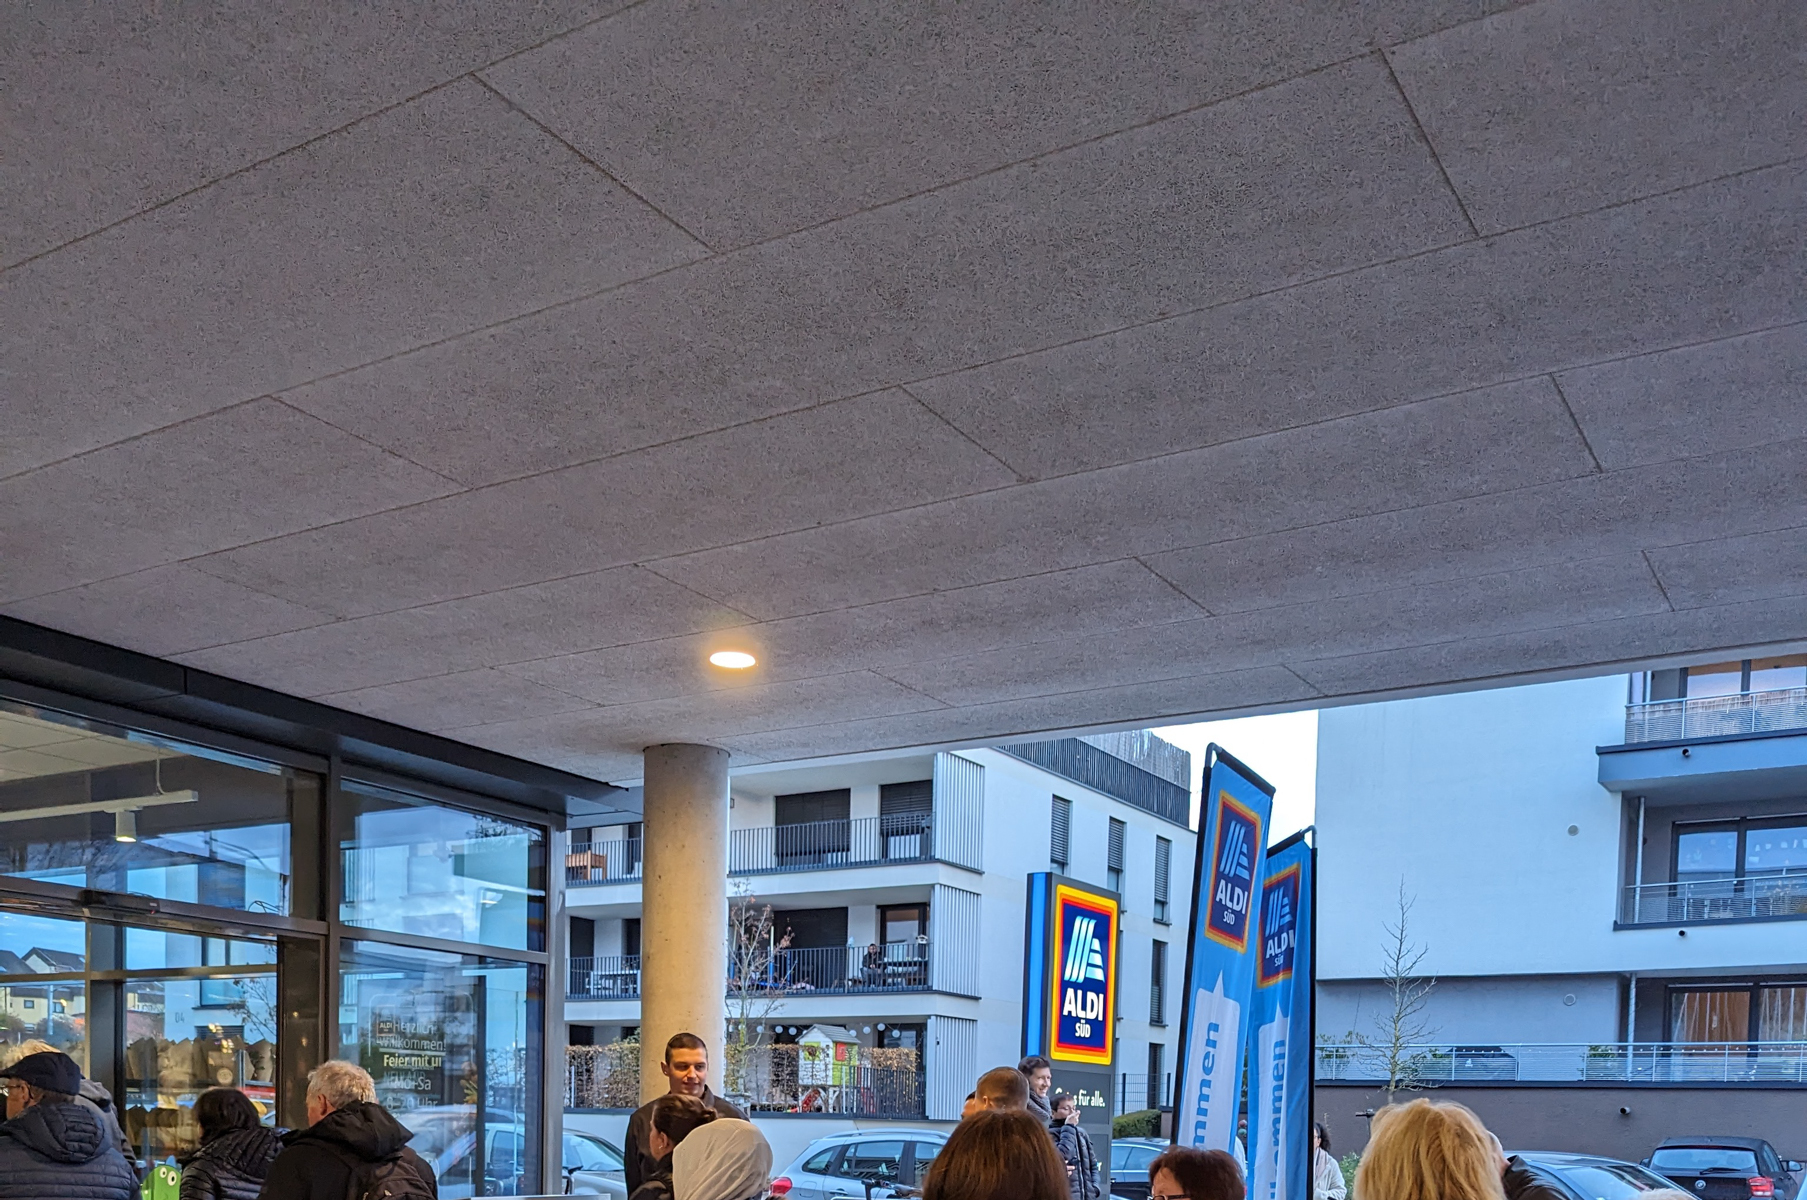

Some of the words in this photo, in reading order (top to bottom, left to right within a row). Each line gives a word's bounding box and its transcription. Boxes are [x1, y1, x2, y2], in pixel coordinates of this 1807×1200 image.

[1215, 879, 1248, 915] ALDI
[1223, 909, 1236, 925] SÜD
[1266, 929, 1295, 959] ALDI
[1062, 987, 1104, 1021] ALDI
[1075, 1019, 1091, 1038] SÜD
[383, 1053, 410, 1067] Feier
[411, 1054, 430, 1068] mit
[1078, 1089, 1090, 1106] für
[1090, 1090, 1106, 1107] alle.
